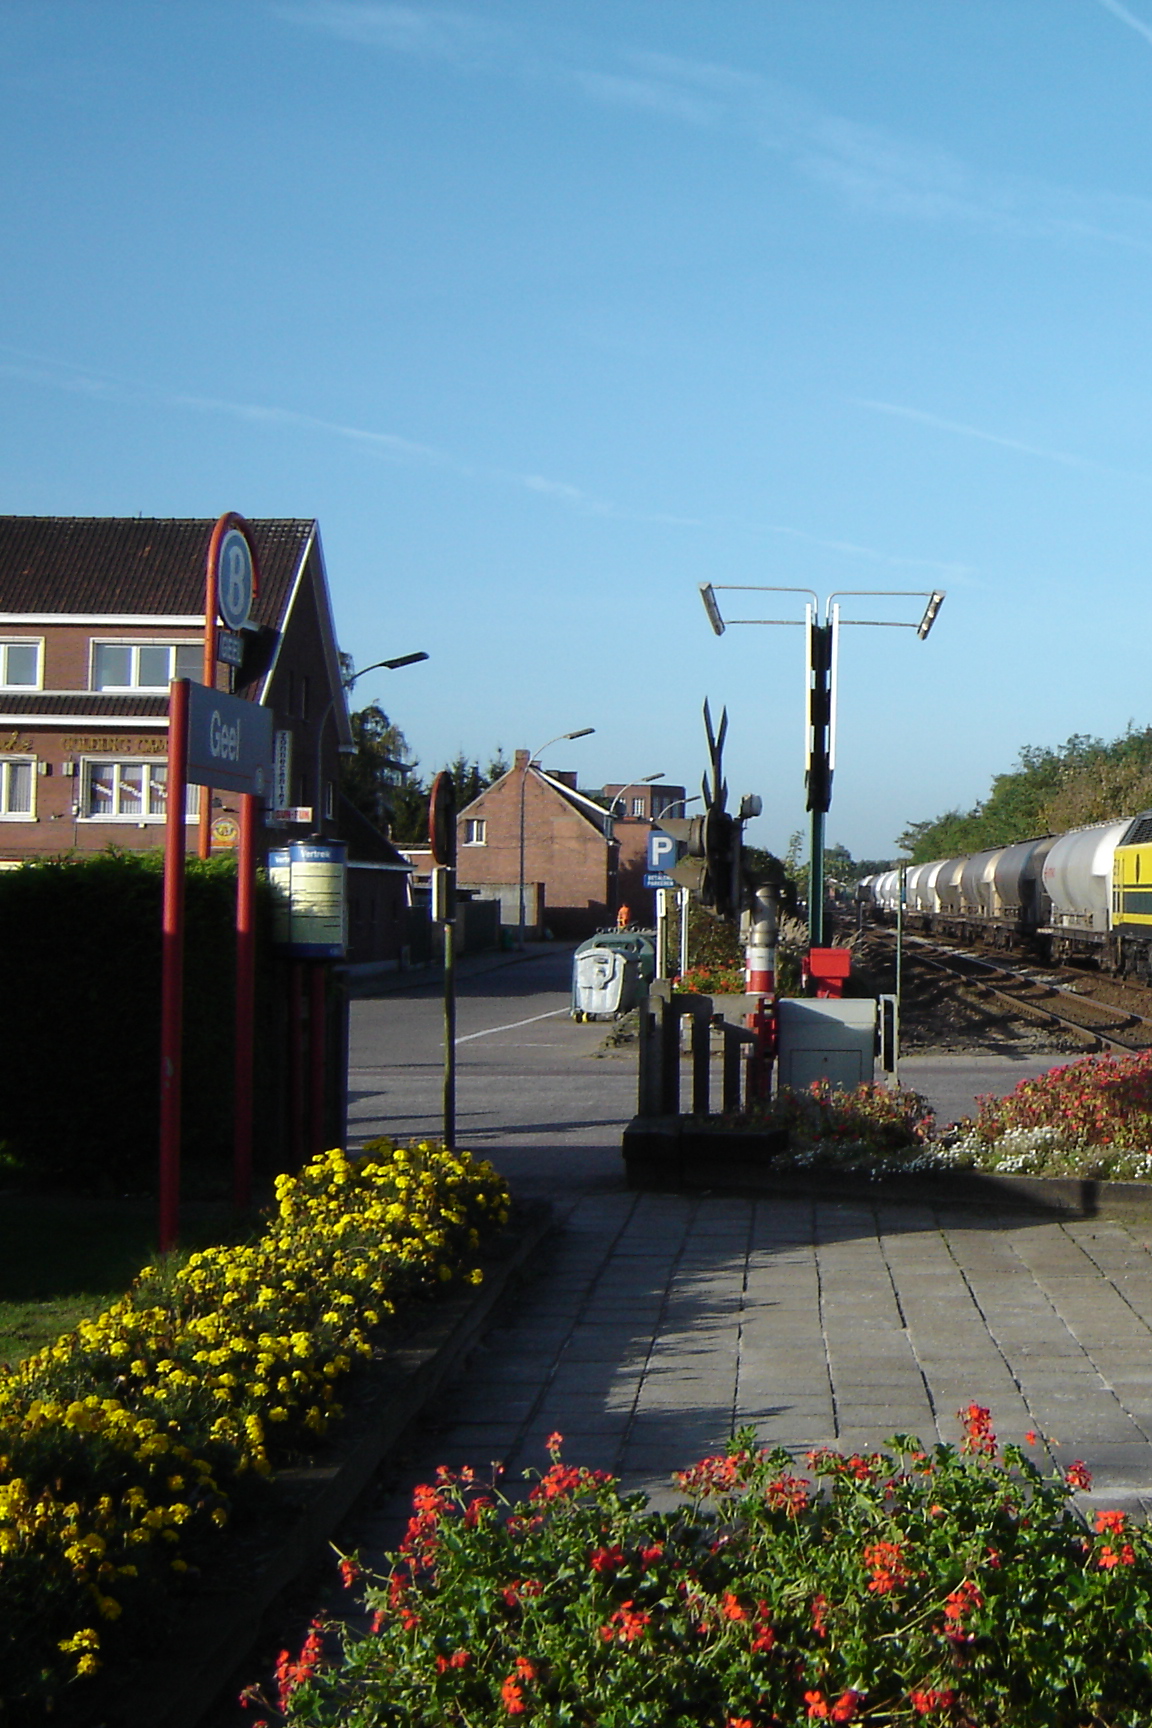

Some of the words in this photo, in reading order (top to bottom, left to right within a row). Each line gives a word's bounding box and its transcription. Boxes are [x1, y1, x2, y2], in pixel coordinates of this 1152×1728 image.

[210, 710, 240, 762] Geel
[300, 849, 332, 859] Vertrek
[652, 836, 673, 866] P
